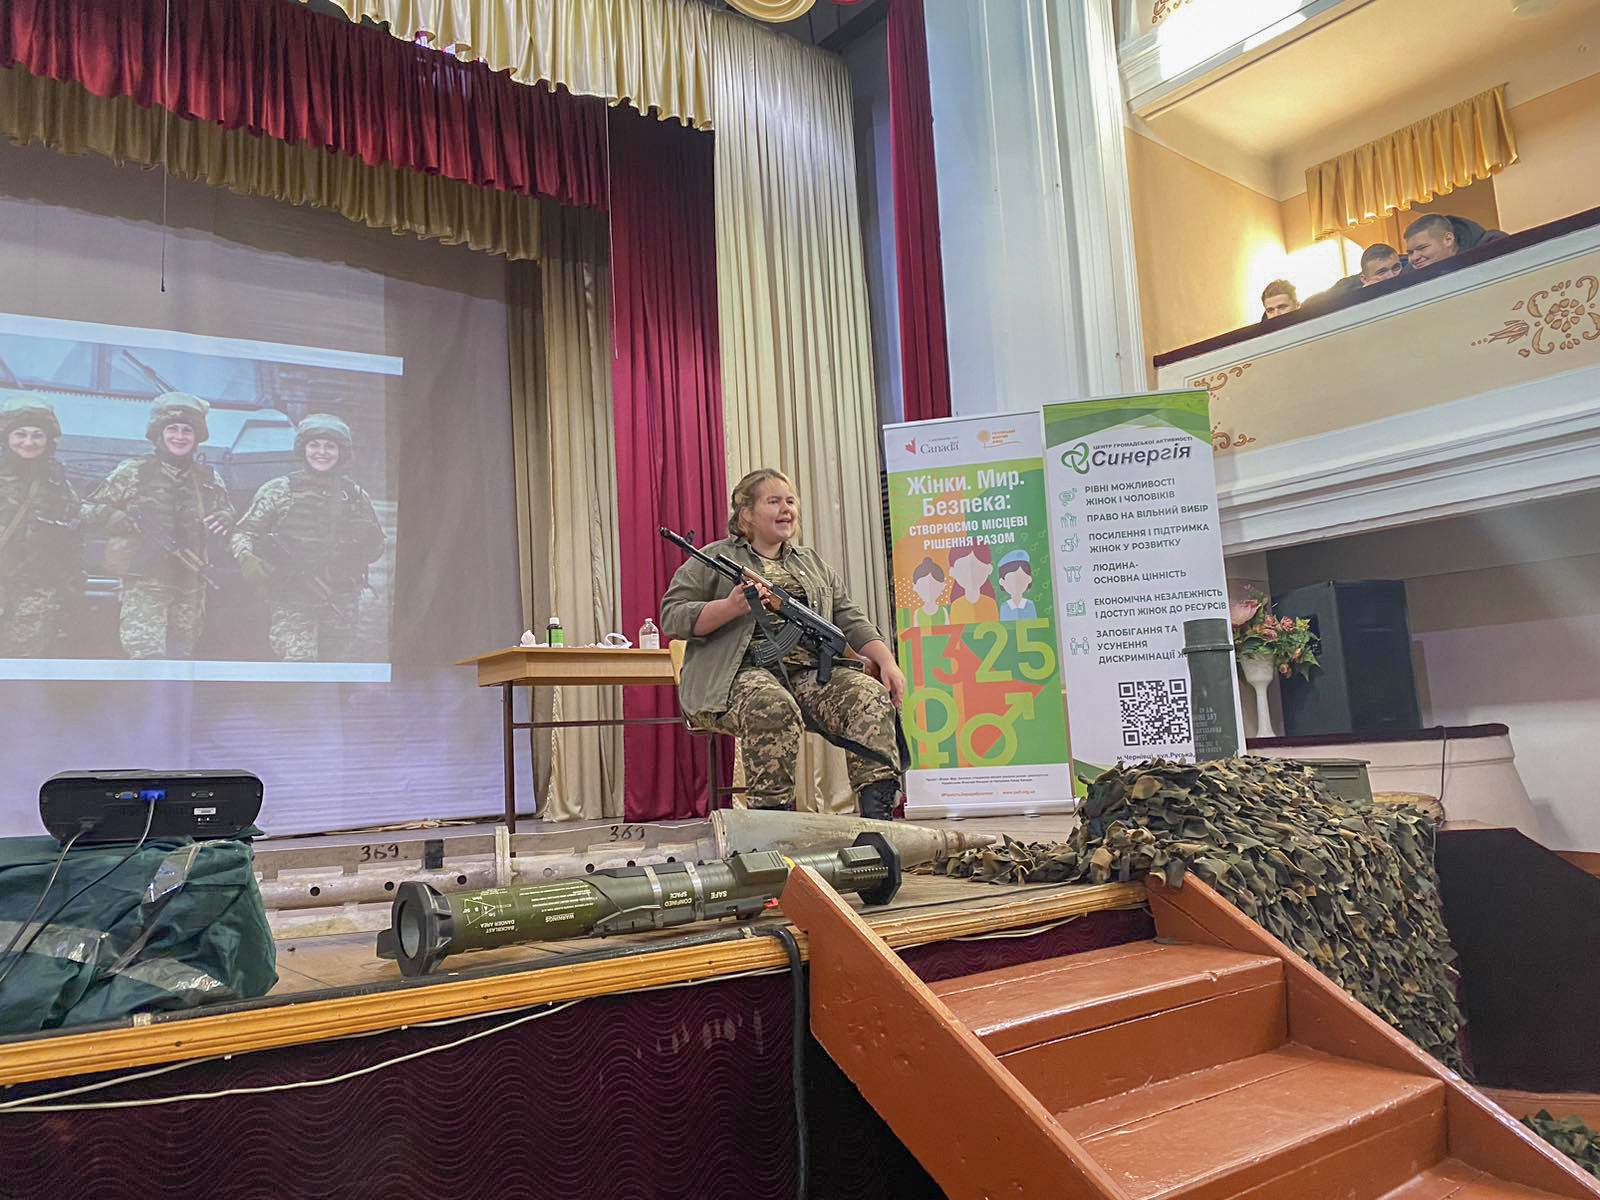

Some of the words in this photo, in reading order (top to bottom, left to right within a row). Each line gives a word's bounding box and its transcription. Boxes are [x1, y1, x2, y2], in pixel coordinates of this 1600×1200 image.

[920, 442, 959, 454] Canada
[1114, 439, 1155, 449] ГРОМАДСЬКОЇ
[1155, 436, 1193, 444] АКТИВНОСТІ
[1092, 443, 1191, 466] Синергія
[906, 475, 972, 496] Жінки.
[977, 468, 1025, 490] Мир.
[1085, 483, 1109, 494] РІВНІ
[1111, 478, 1176, 491] МОЖЛИВОСТІ
[922, 494, 1012, 517] Безпека:
[1086, 495, 1117, 506] ЖІНОК
[1124, 490, 1176, 503] ЧОЛОВІКІВ
[1087, 512, 1119, 522] ПРАВО
[1121, 511, 1135, 520] НА
[1136, 505, 1179, 518] ВІЛЬНИЙ
[1181, 504, 1209, 514] ВИБІР
[909, 520, 978, 537] СТВОРЮЄМО
[982, 516, 1028, 530] МІСЦЕВІ
[1089, 529, 1146, 541] ПОСИЛЕННЯ
[1148, 528, 1151, 536] І
[1153, 523, 1210, 536] ПІДТРИМКА
[923, 537, 974, 551] РІШЕННЯ
[976, 532, 1015, 546] РАЗОМ
[1089, 543, 1121, 554] ЖІНОК
[1123, 543, 1130, 551] У
[1132, 538, 1182, 550] РОЗВИТКУ
[1092, 561, 1139, 572] ЛЮДИНА-
[1093, 574, 1140, 584] ОСНОВНА
[1142, 569, 1187, 581] ЦІННІСТЬ
[1094, 594, 1152, 606] ЕКОНОМІЧНА
[1154, 589, 1223, 601] НЕЗАЛЕЖНІСТЬ
[1095, 611, 1098, 619] І
[1100, 608, 1136, 620] ДОСТУП
[1137, 606, 1168, 616] ЖІНОК
[1169, 604, 1183, 614] ДО
[1184, 601, 1227, 612] РЕСУРСІВ
[1096, 626, 1163, 638] ЗАПОБІГАННЯ
[1165, 625, 1178, 633] ТА
[1097, 640, 1148, 651] УСУНЕННЯ
[1098, 650, 1176, 664] ДИСКРИМІНАЦІЇ
[664, 897, 693, 907] CONFINED
[710, 890, 728, 899] SAFE
[494, 919, 515, 927] DANGER
[545, 912, 575, 923] WARNINGS
[486, 925, 515, 933] BACKBLAST
